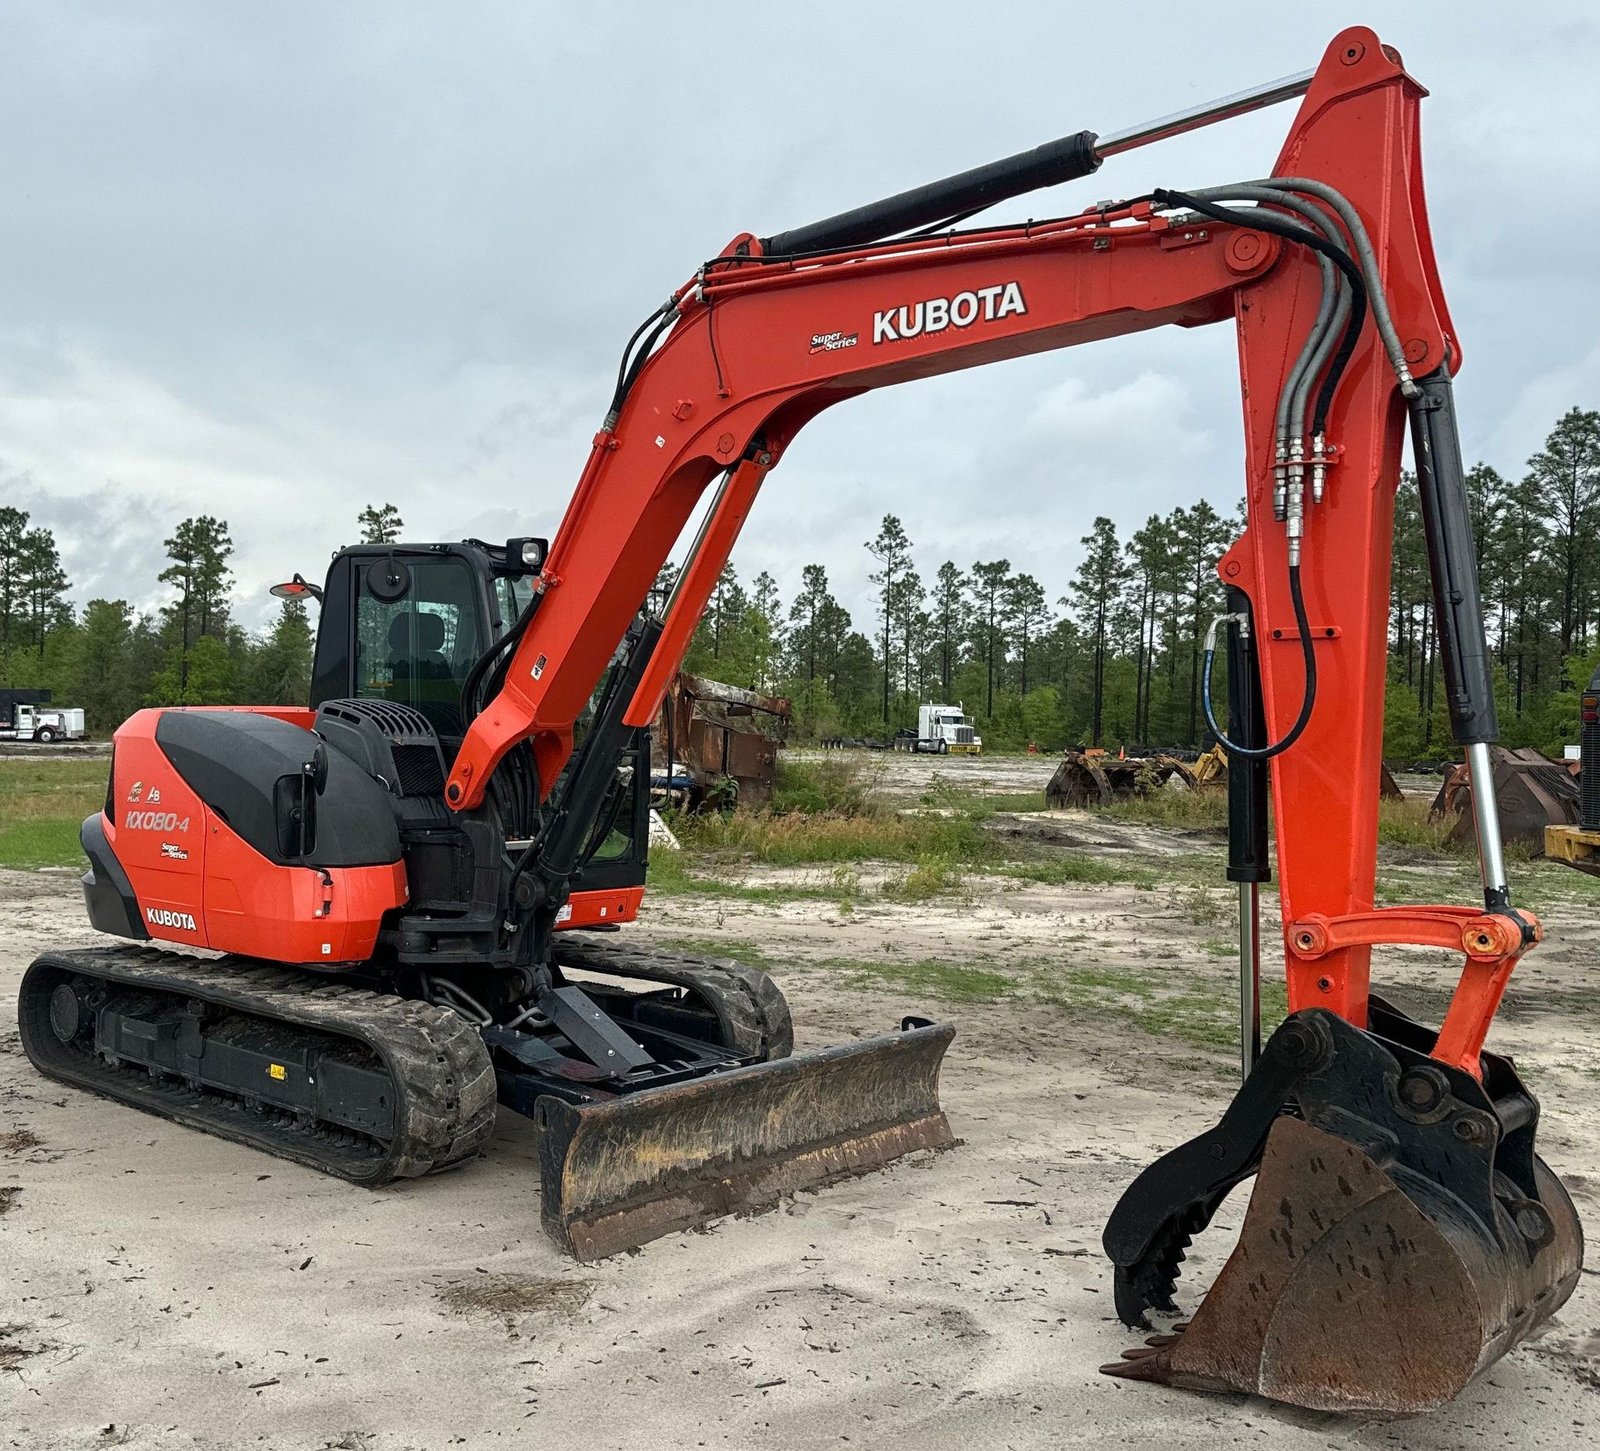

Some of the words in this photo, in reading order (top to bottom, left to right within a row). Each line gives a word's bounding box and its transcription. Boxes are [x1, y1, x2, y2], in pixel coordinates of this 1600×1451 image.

[873, 282, 1026, 344] KUBOTA
[811, 331, 842, 347] Super
[825, 336, 858, 351] Series
[125, 810, 190, 833] KX080-4
[161, 842, 179, 853] Super
[169, 850, 188, 860] Series
[146, 907, 197, 931] KUBOTA
